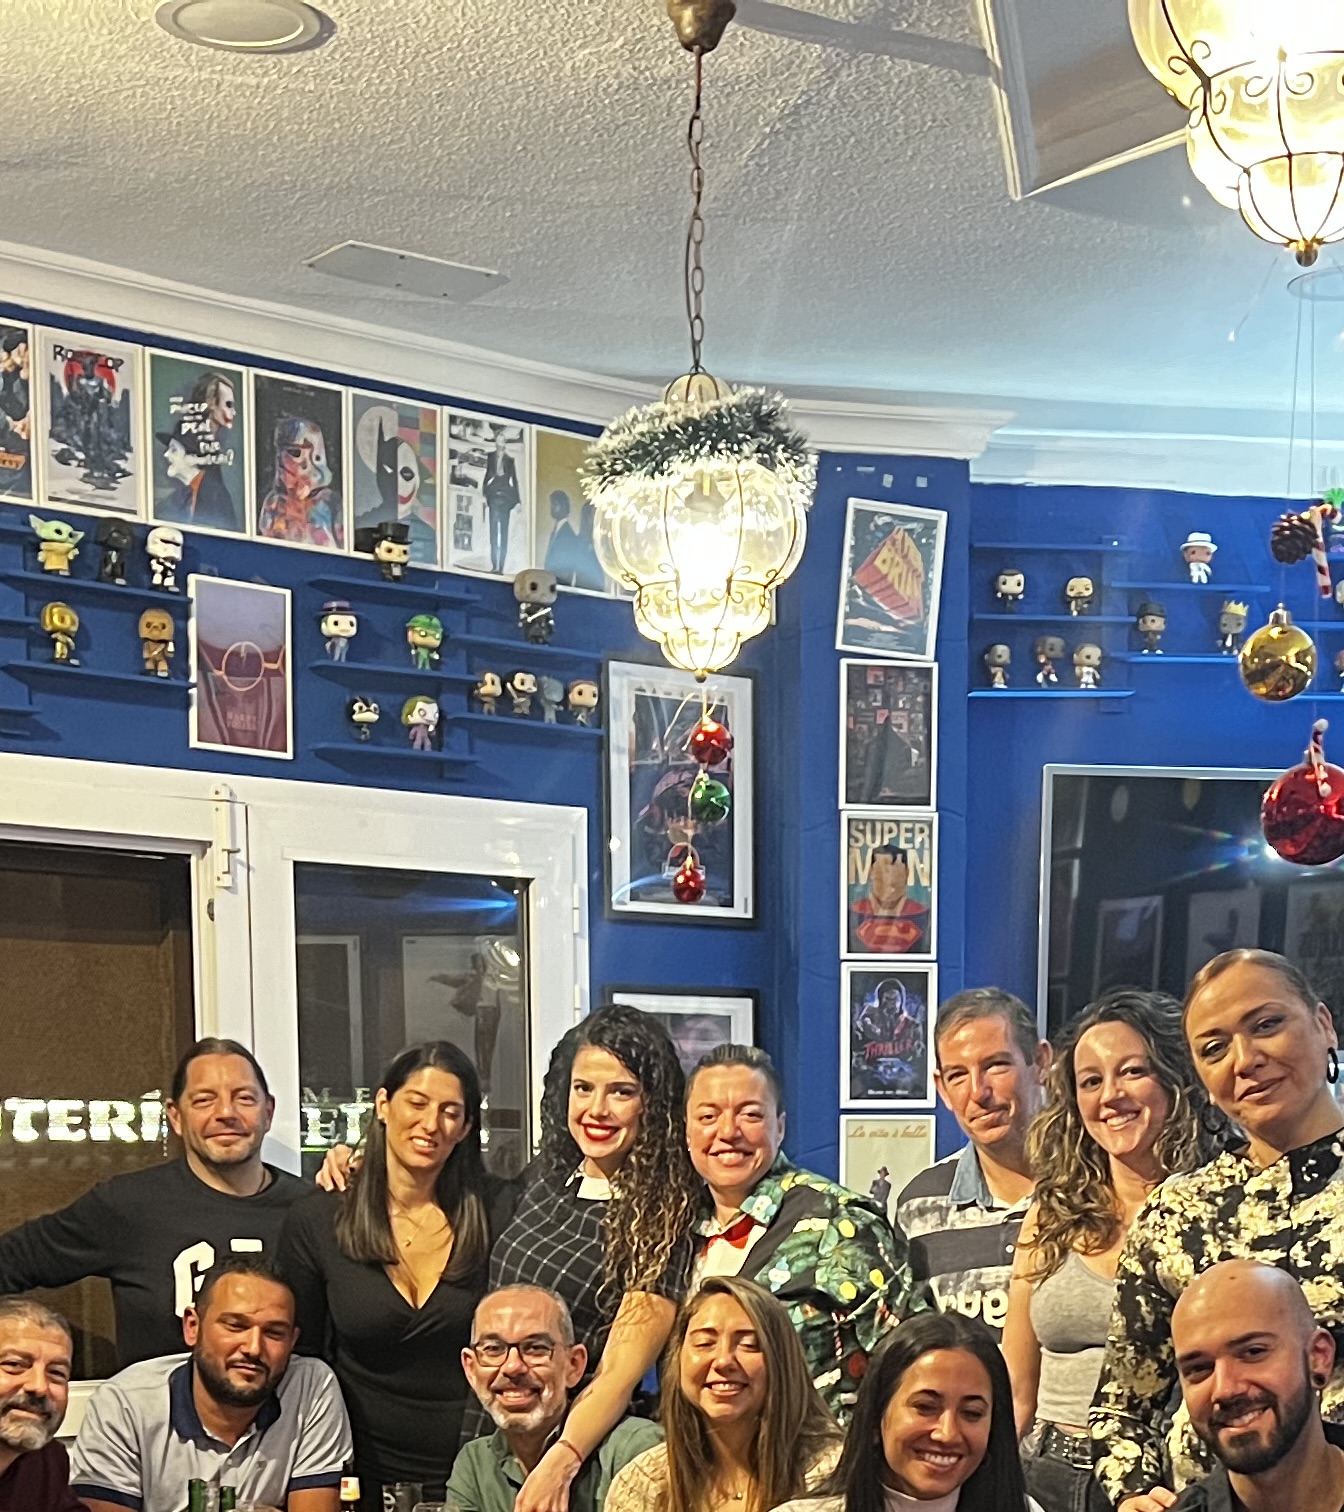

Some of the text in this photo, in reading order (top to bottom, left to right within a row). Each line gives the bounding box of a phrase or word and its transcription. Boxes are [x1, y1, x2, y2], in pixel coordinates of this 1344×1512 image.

[849, 821, 931, 849] SUPER
[848, 847, 931, 887] MN
[863, 1037, 914, 1061] THRILLER
